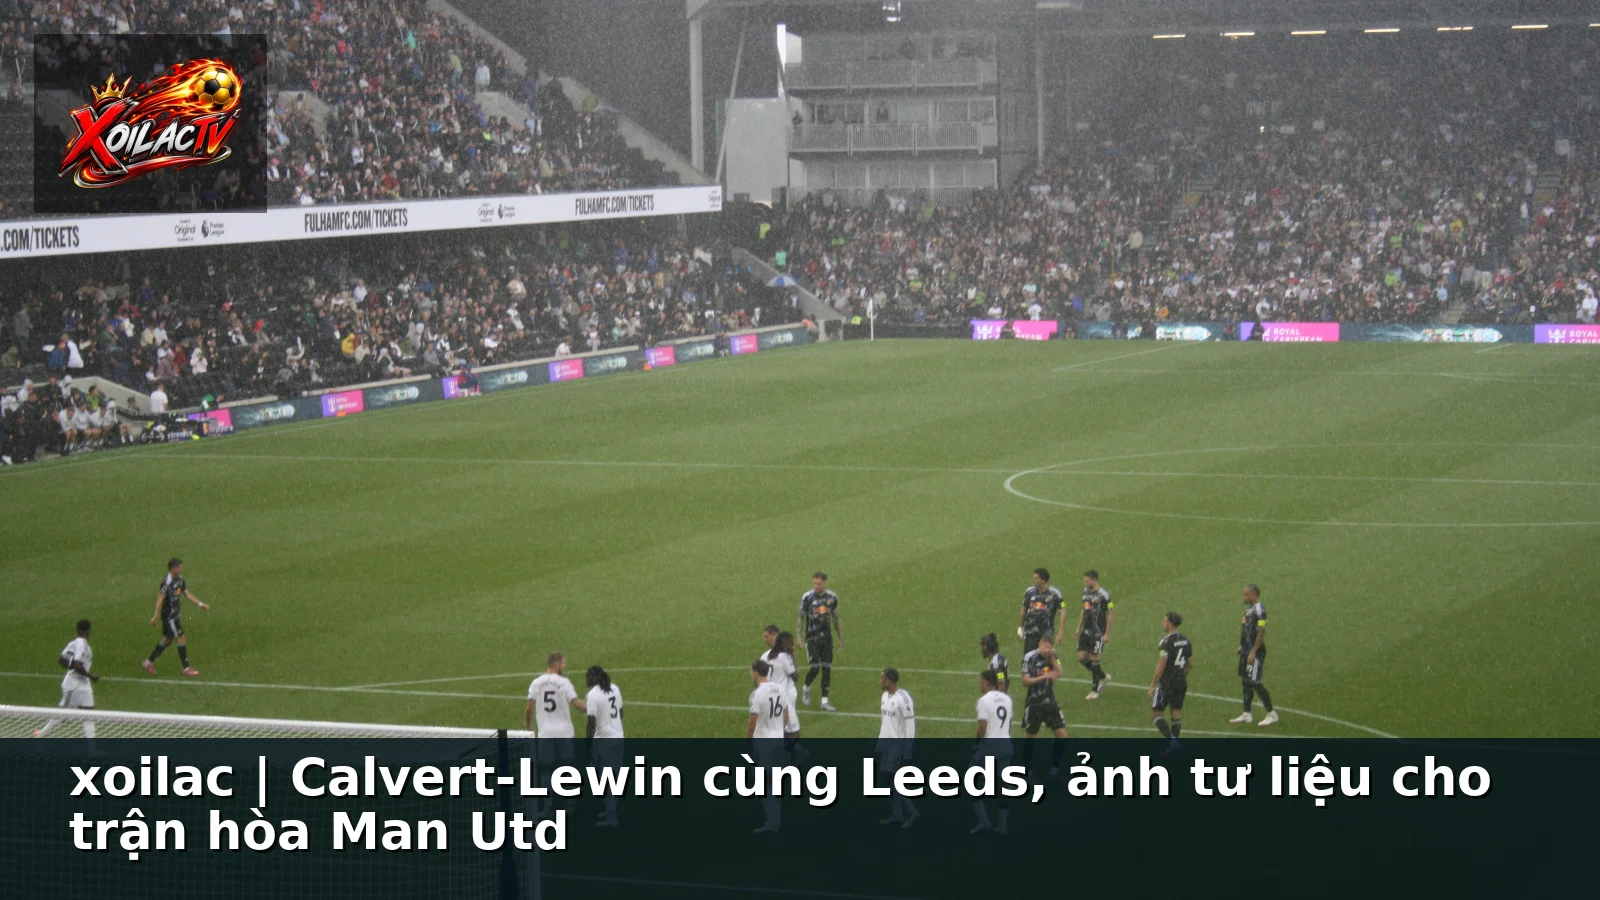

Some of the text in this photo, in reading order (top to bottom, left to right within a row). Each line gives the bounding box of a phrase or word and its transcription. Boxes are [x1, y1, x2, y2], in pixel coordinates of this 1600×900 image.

[575, 194, 656, 216] FULHAMFC.COM/TICKETS
[304, 207, 409, 233] FULHAMFC.COM/TICKETS
[1273, 328, 1300, 336] ROYAL
[1569, 330, 1599, 338] ROYAL
[1174, 647, 1187, 669] 4
[543, 690, 557, 713] 5
[608, 696, 618, 719] 3
[769, 695, 783, 719] 16
[996, 705, 1007, 729] 9
